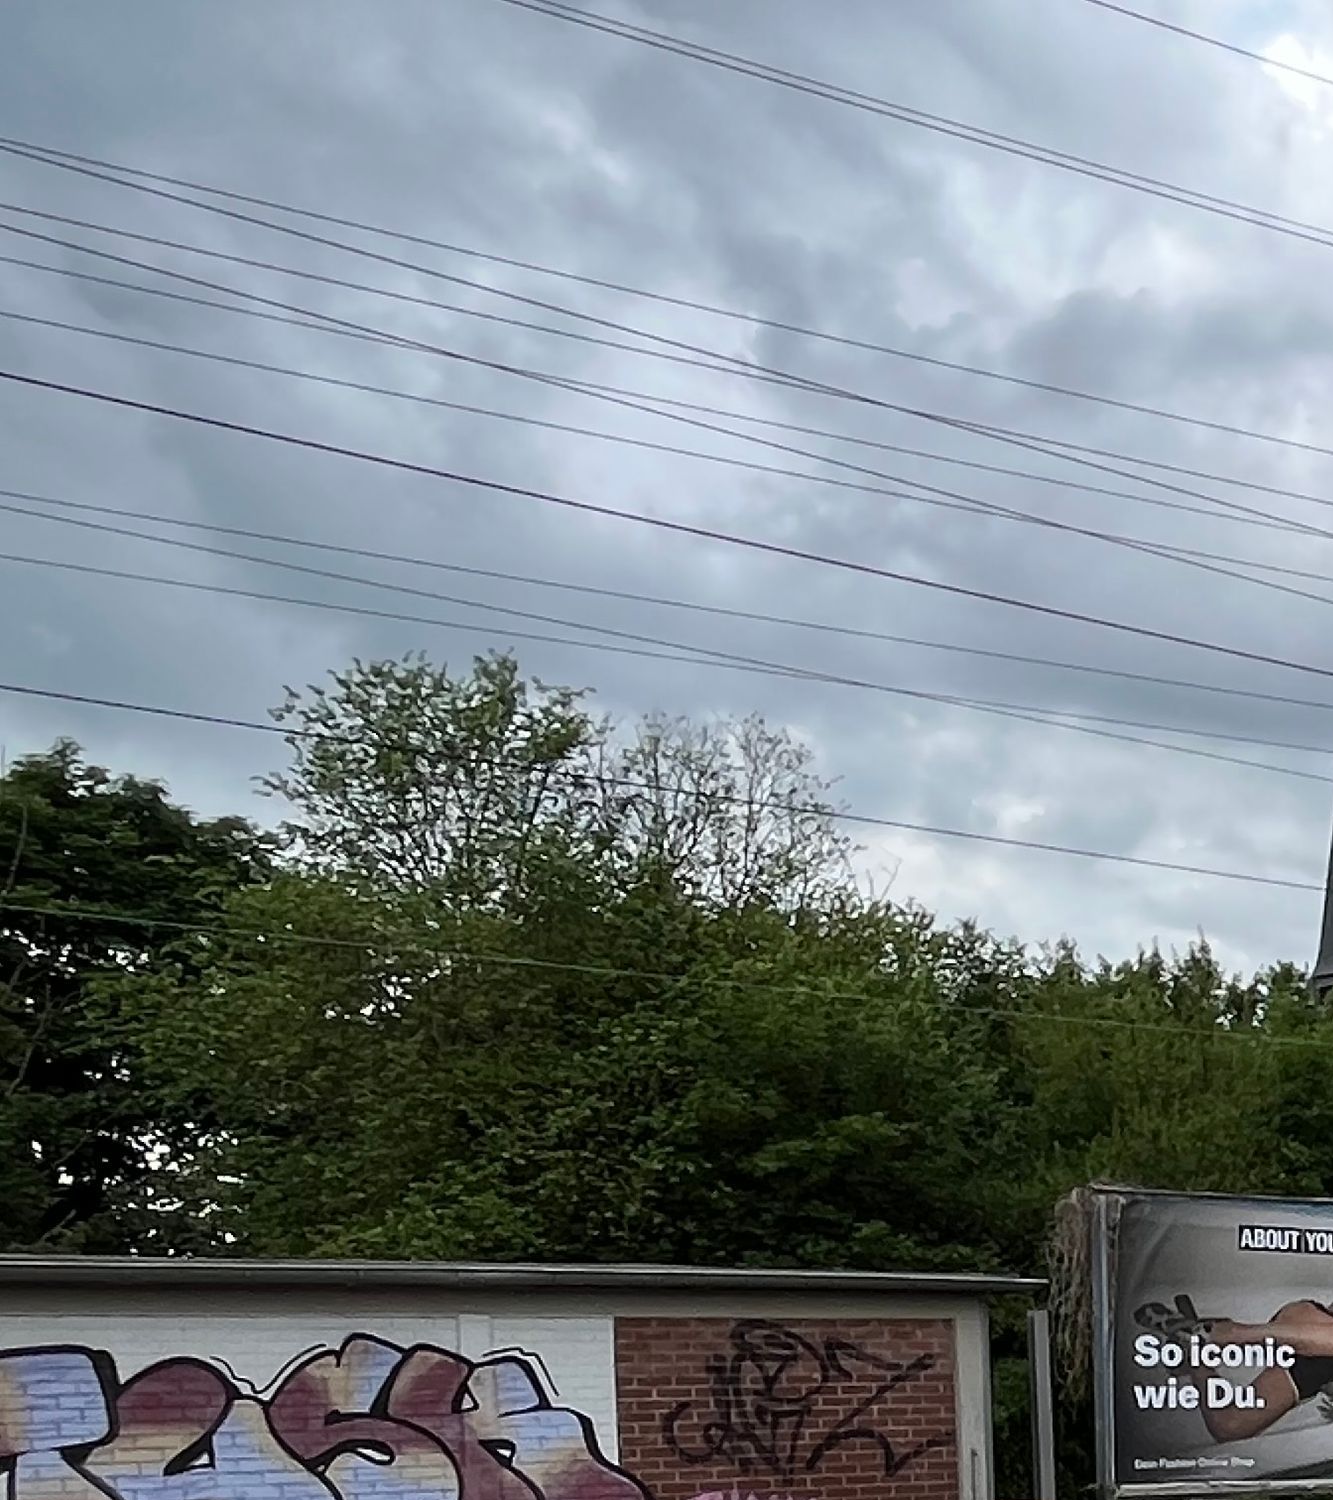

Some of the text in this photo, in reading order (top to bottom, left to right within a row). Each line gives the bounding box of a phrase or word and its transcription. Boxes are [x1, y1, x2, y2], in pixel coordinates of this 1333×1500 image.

[1240, 1228, 1300, 1250] ABOUT
[1134, 1334, 1296, 1368] So iconic
[1133, 1377, 1266, 1409] wie Du.
